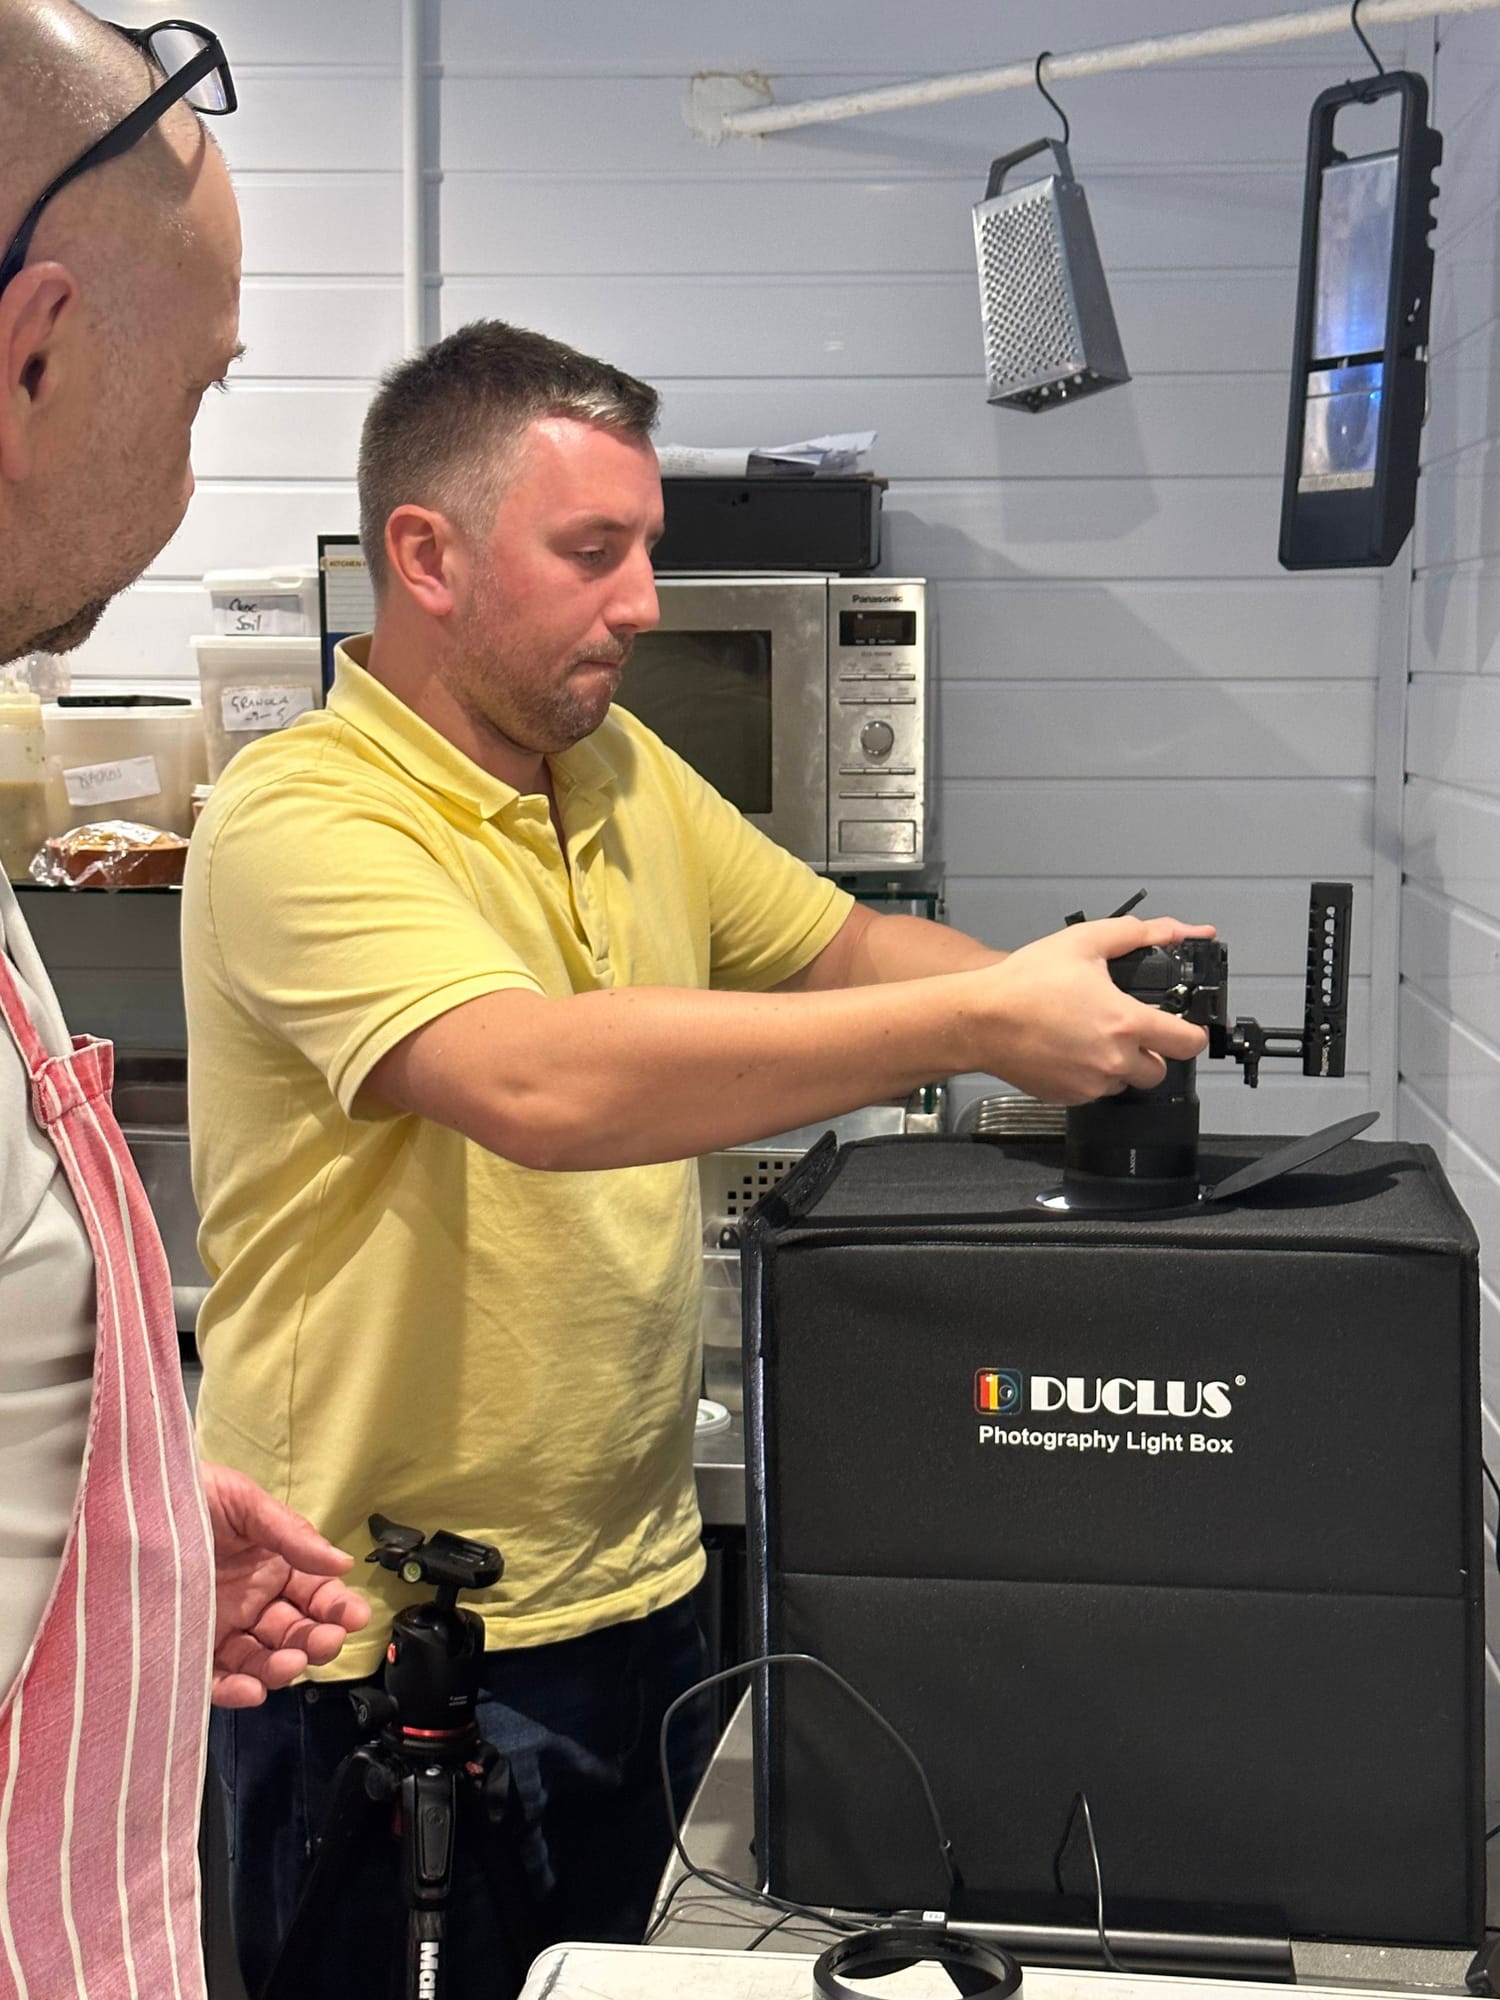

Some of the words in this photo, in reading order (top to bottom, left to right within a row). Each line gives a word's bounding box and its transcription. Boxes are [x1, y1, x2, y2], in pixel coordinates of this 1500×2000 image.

[852, 594, 904, 604] Panasonic
[978, 1425, 1120, 1453] Photography
[1126, 1432, 1184, 1455] Light
[1189, 1434, 1234, 1453] Box
